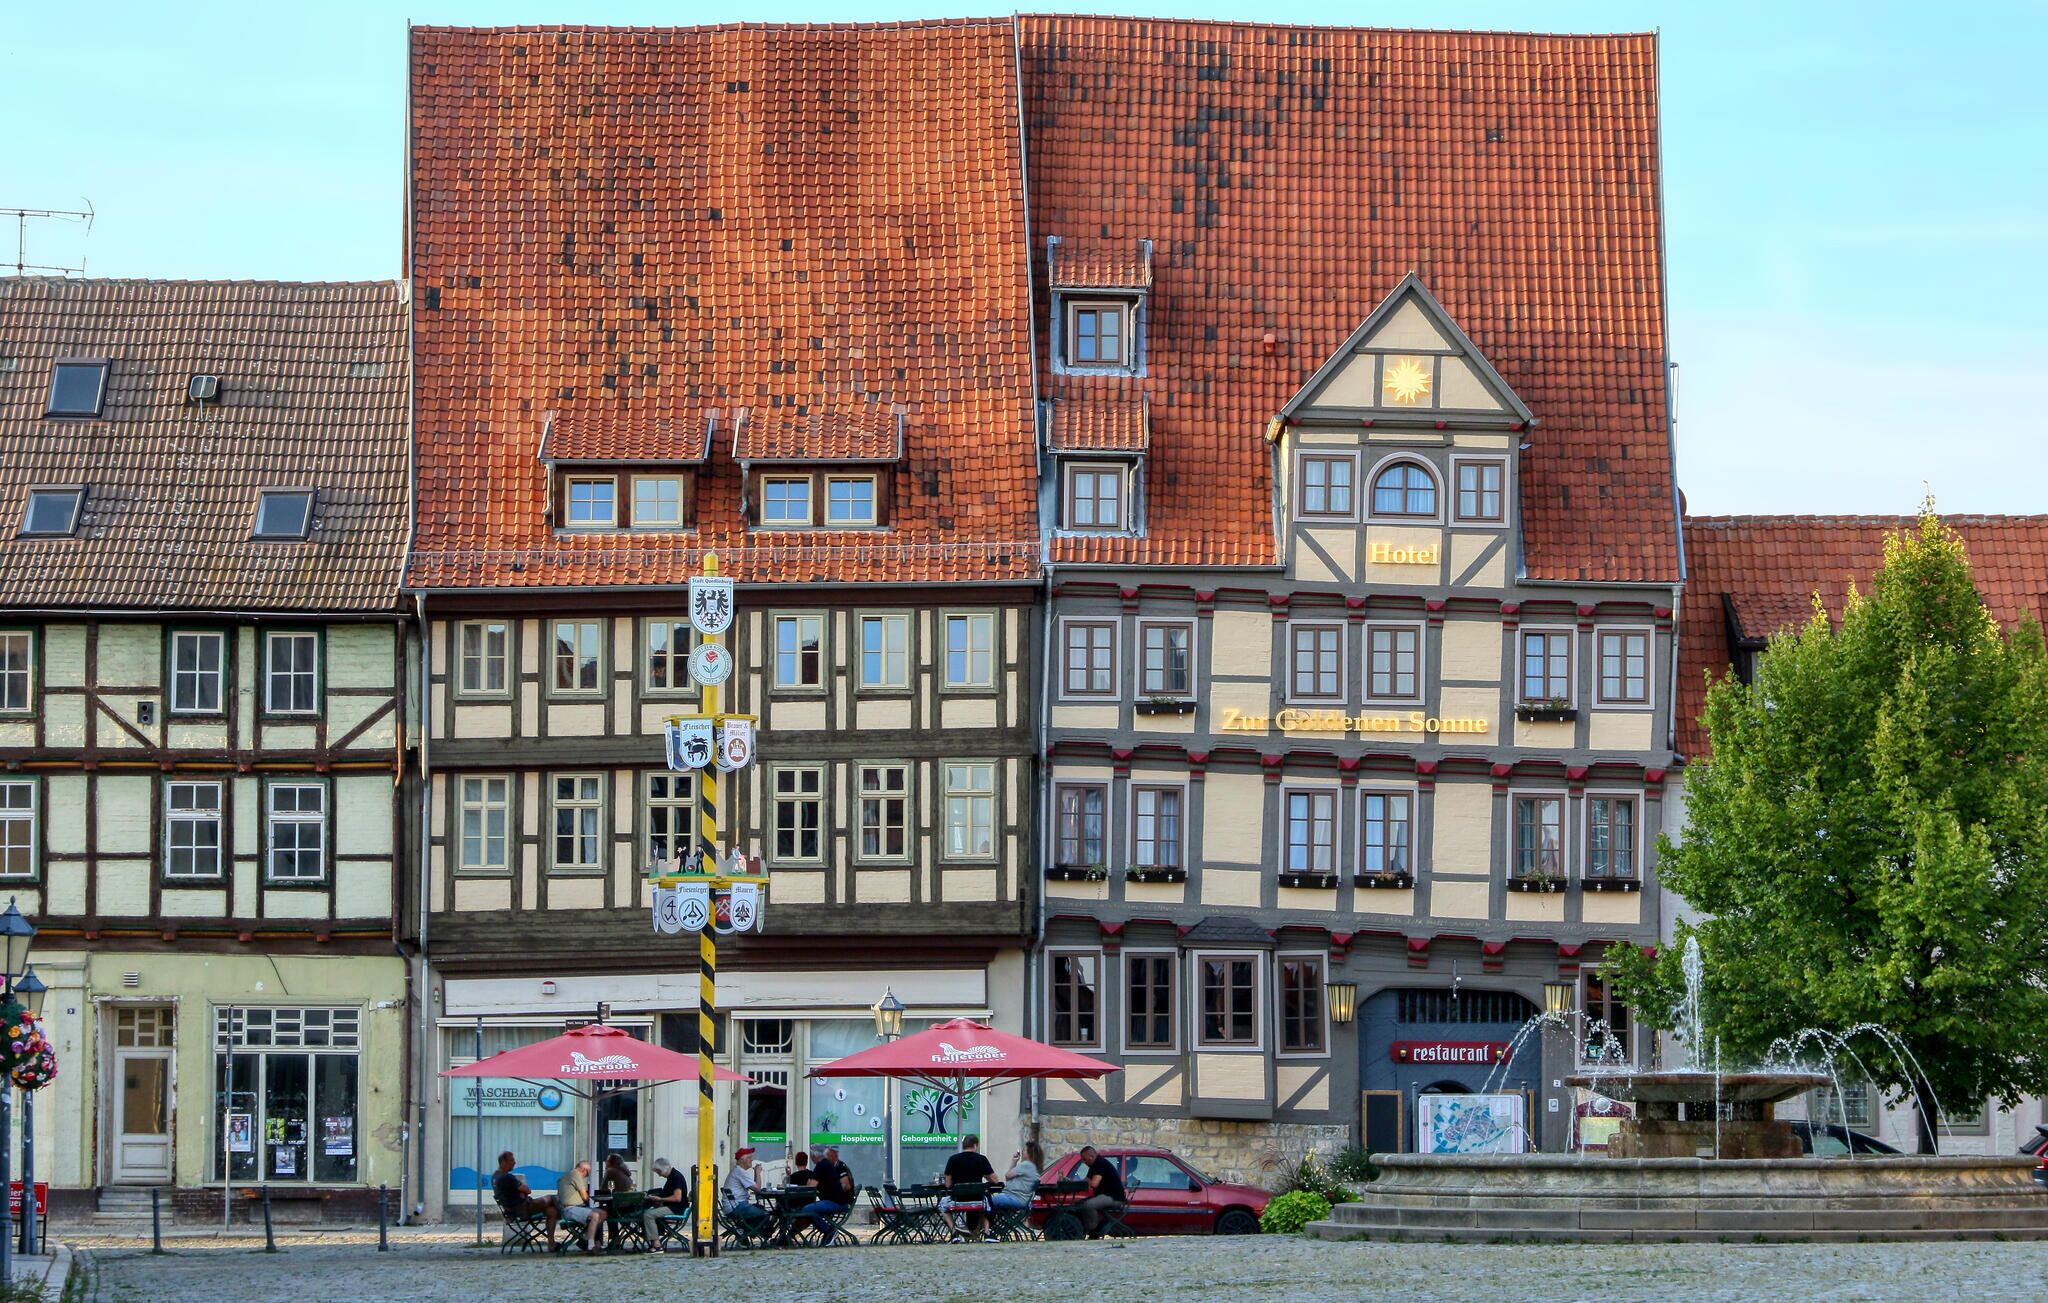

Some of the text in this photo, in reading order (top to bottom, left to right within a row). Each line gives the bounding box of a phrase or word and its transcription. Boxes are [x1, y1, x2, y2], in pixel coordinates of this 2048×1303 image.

[1369, 543, 1438, 564] Hotel
[1222, 708, 1488, 733] Zur Goldenen Sonne
[682, 723, 710, 731] Fleischer
[679, 886, 707, 894] Fliesenleger
[735, 886, 753, 894] Maurer
[1413, 1044, 1489, 1061] restaurant
[467, 1088, 537, 1098] WASCHBAR
[499, 1100, 536, 1108] Kirchhoff
[841, 1135, 884, 1144] Hospizverei
[901, 1135, 951, 1144] Geborgenheit
